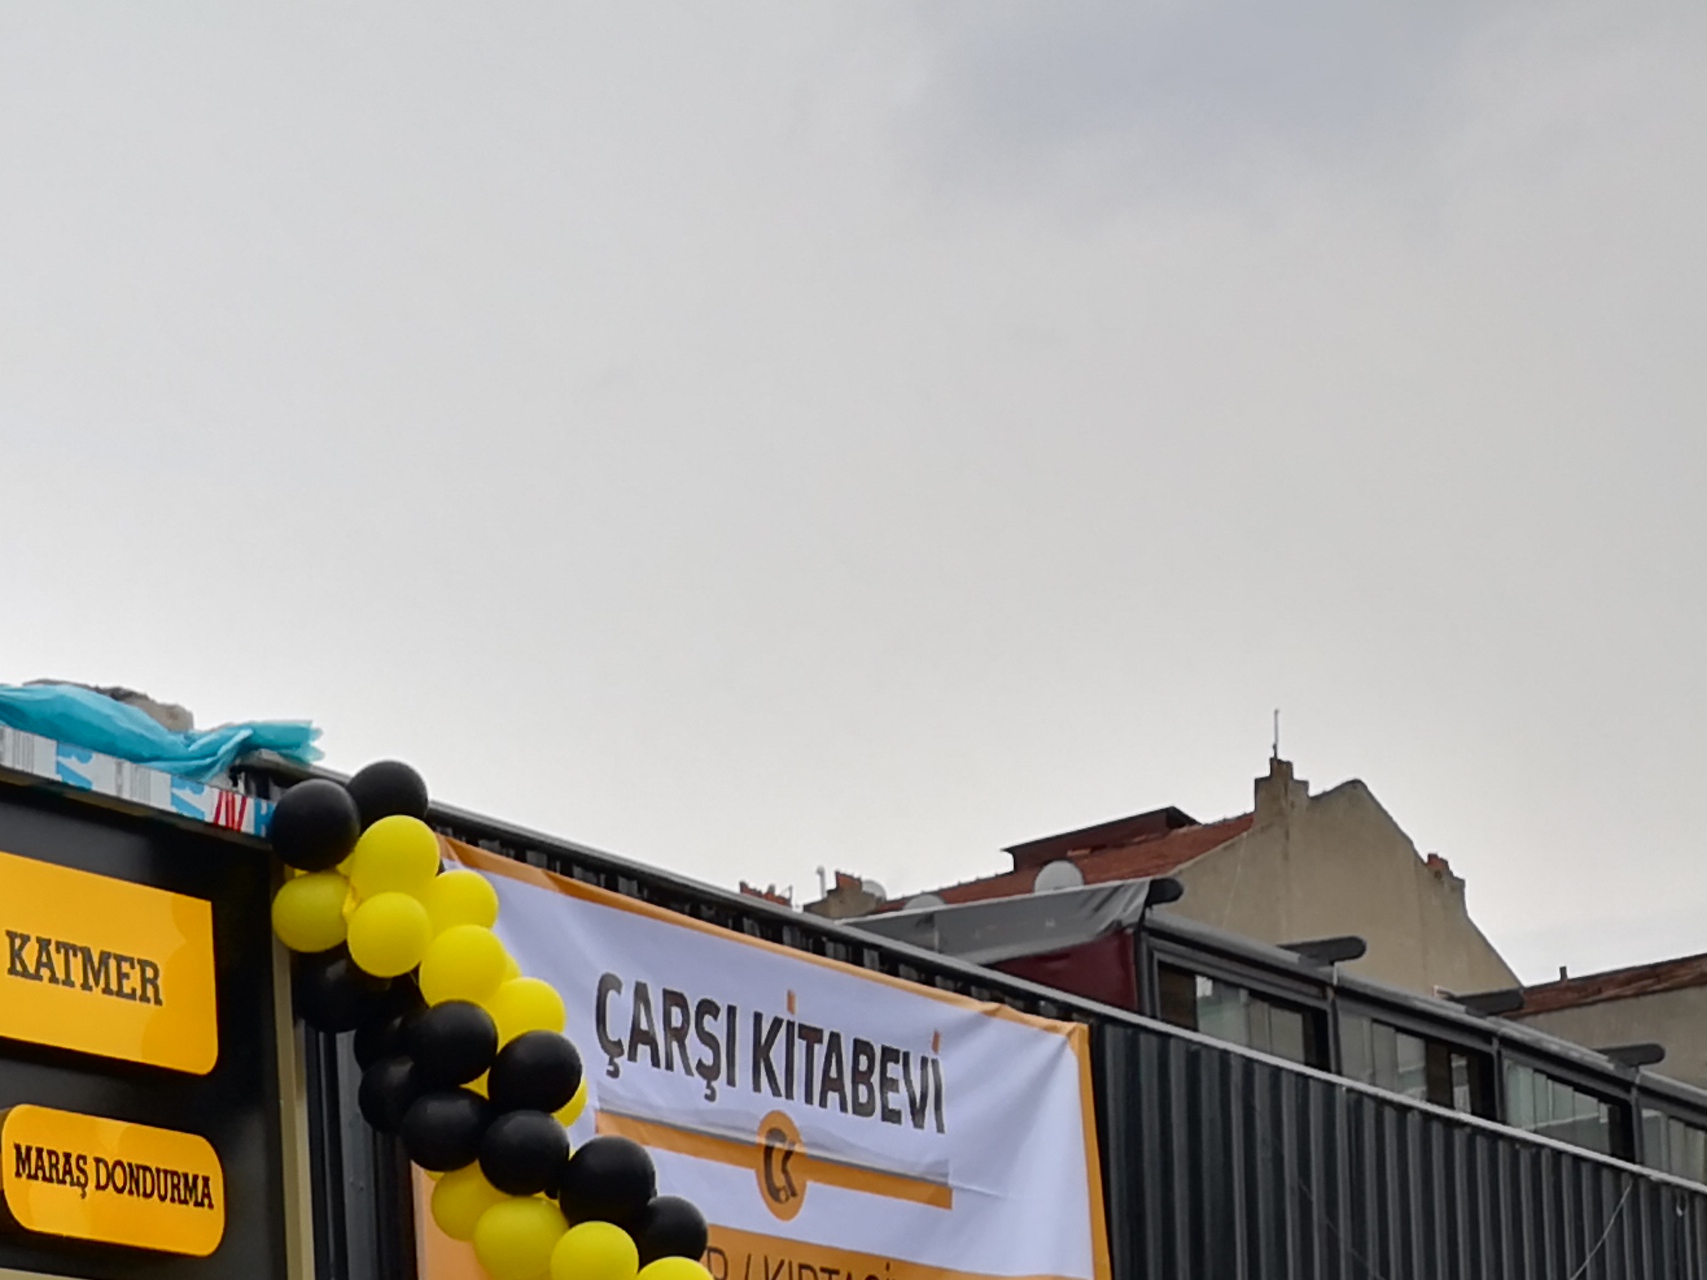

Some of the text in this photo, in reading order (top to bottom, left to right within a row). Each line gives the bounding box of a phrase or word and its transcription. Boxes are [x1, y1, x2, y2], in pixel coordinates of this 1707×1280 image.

[5, 929, 164, 1007] KATMER
[596, 972, 946, 1135] ÇARŞI KİTABEVİ
[13, 1143, 215, 1211] MARAŞ DONDURMA
